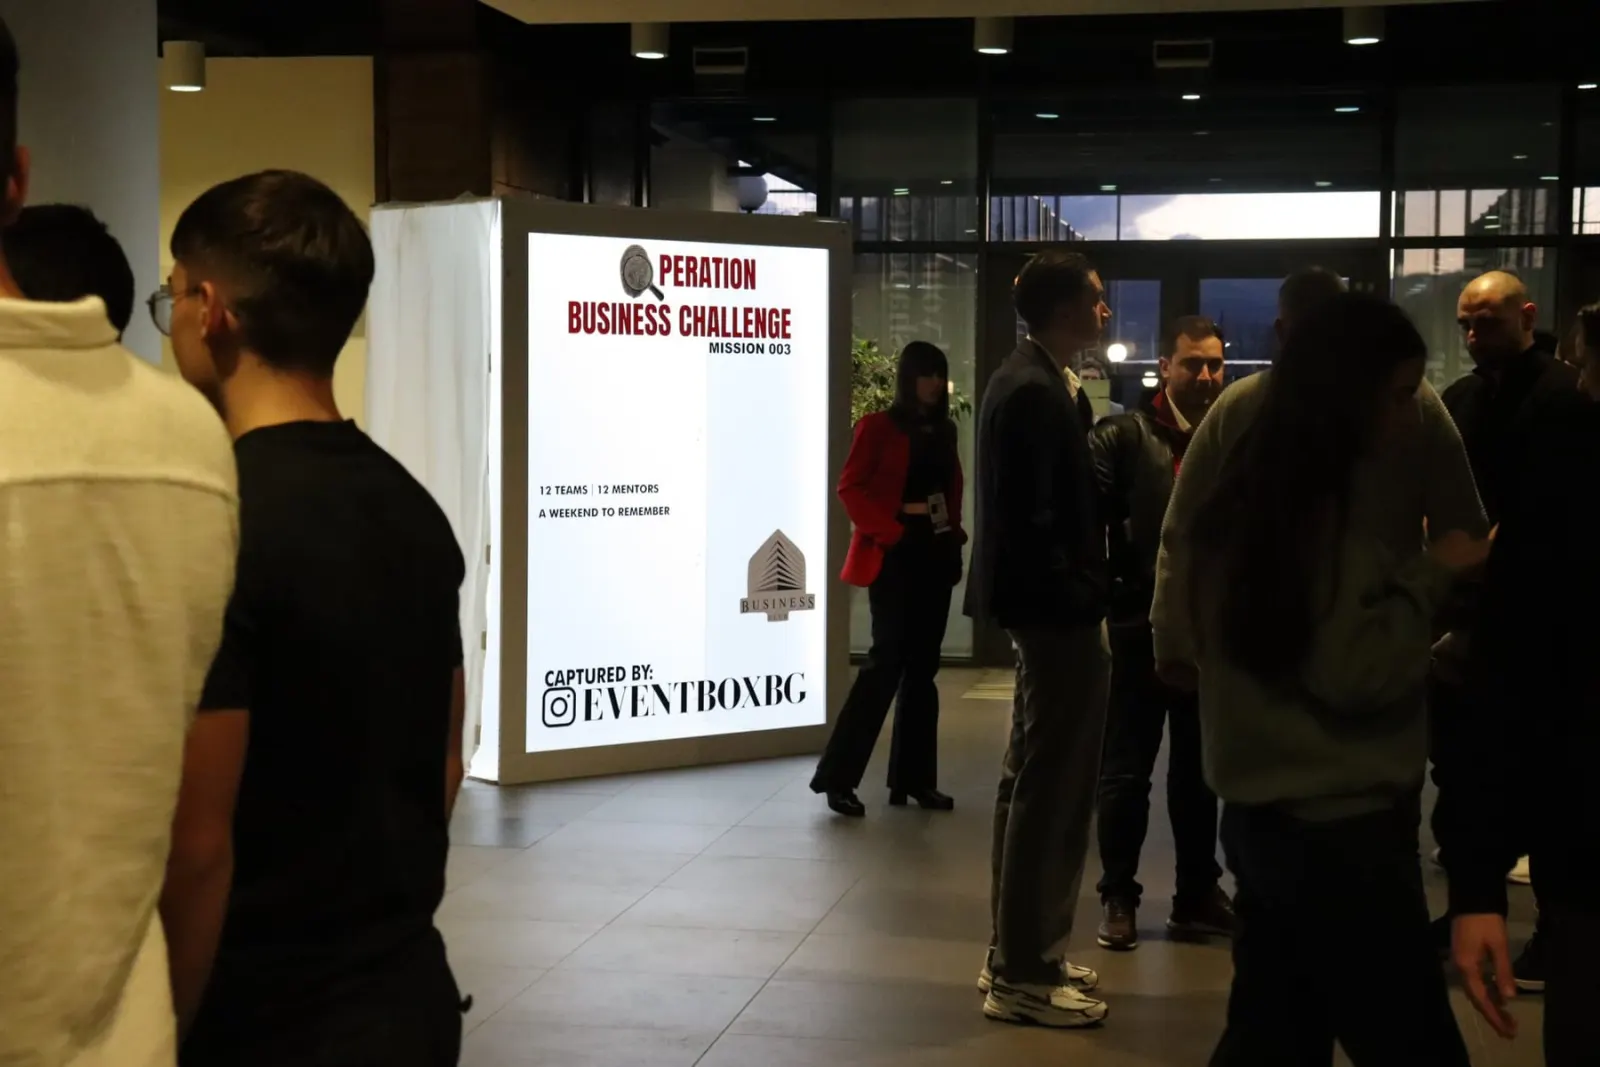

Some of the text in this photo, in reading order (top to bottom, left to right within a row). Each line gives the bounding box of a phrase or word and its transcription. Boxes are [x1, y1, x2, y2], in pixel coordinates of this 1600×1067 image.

[659, 254, 756, 290] PERATION
[568, 301, 791, 339] BUSINESS CHALLENGE
[709, 342, 791, 355] MISSION 003
[540, 484, 659, 495] 12 TEAMS 12 MENTORS
[539, 506, 670, 518] A WEEKEND TO REMEMBER
[742, 596, 815, 613] BUSINESS
[545, 664, 653, 687] CAPTURED BY:
[583, 672, 807, 721] EVENTBOXBG
